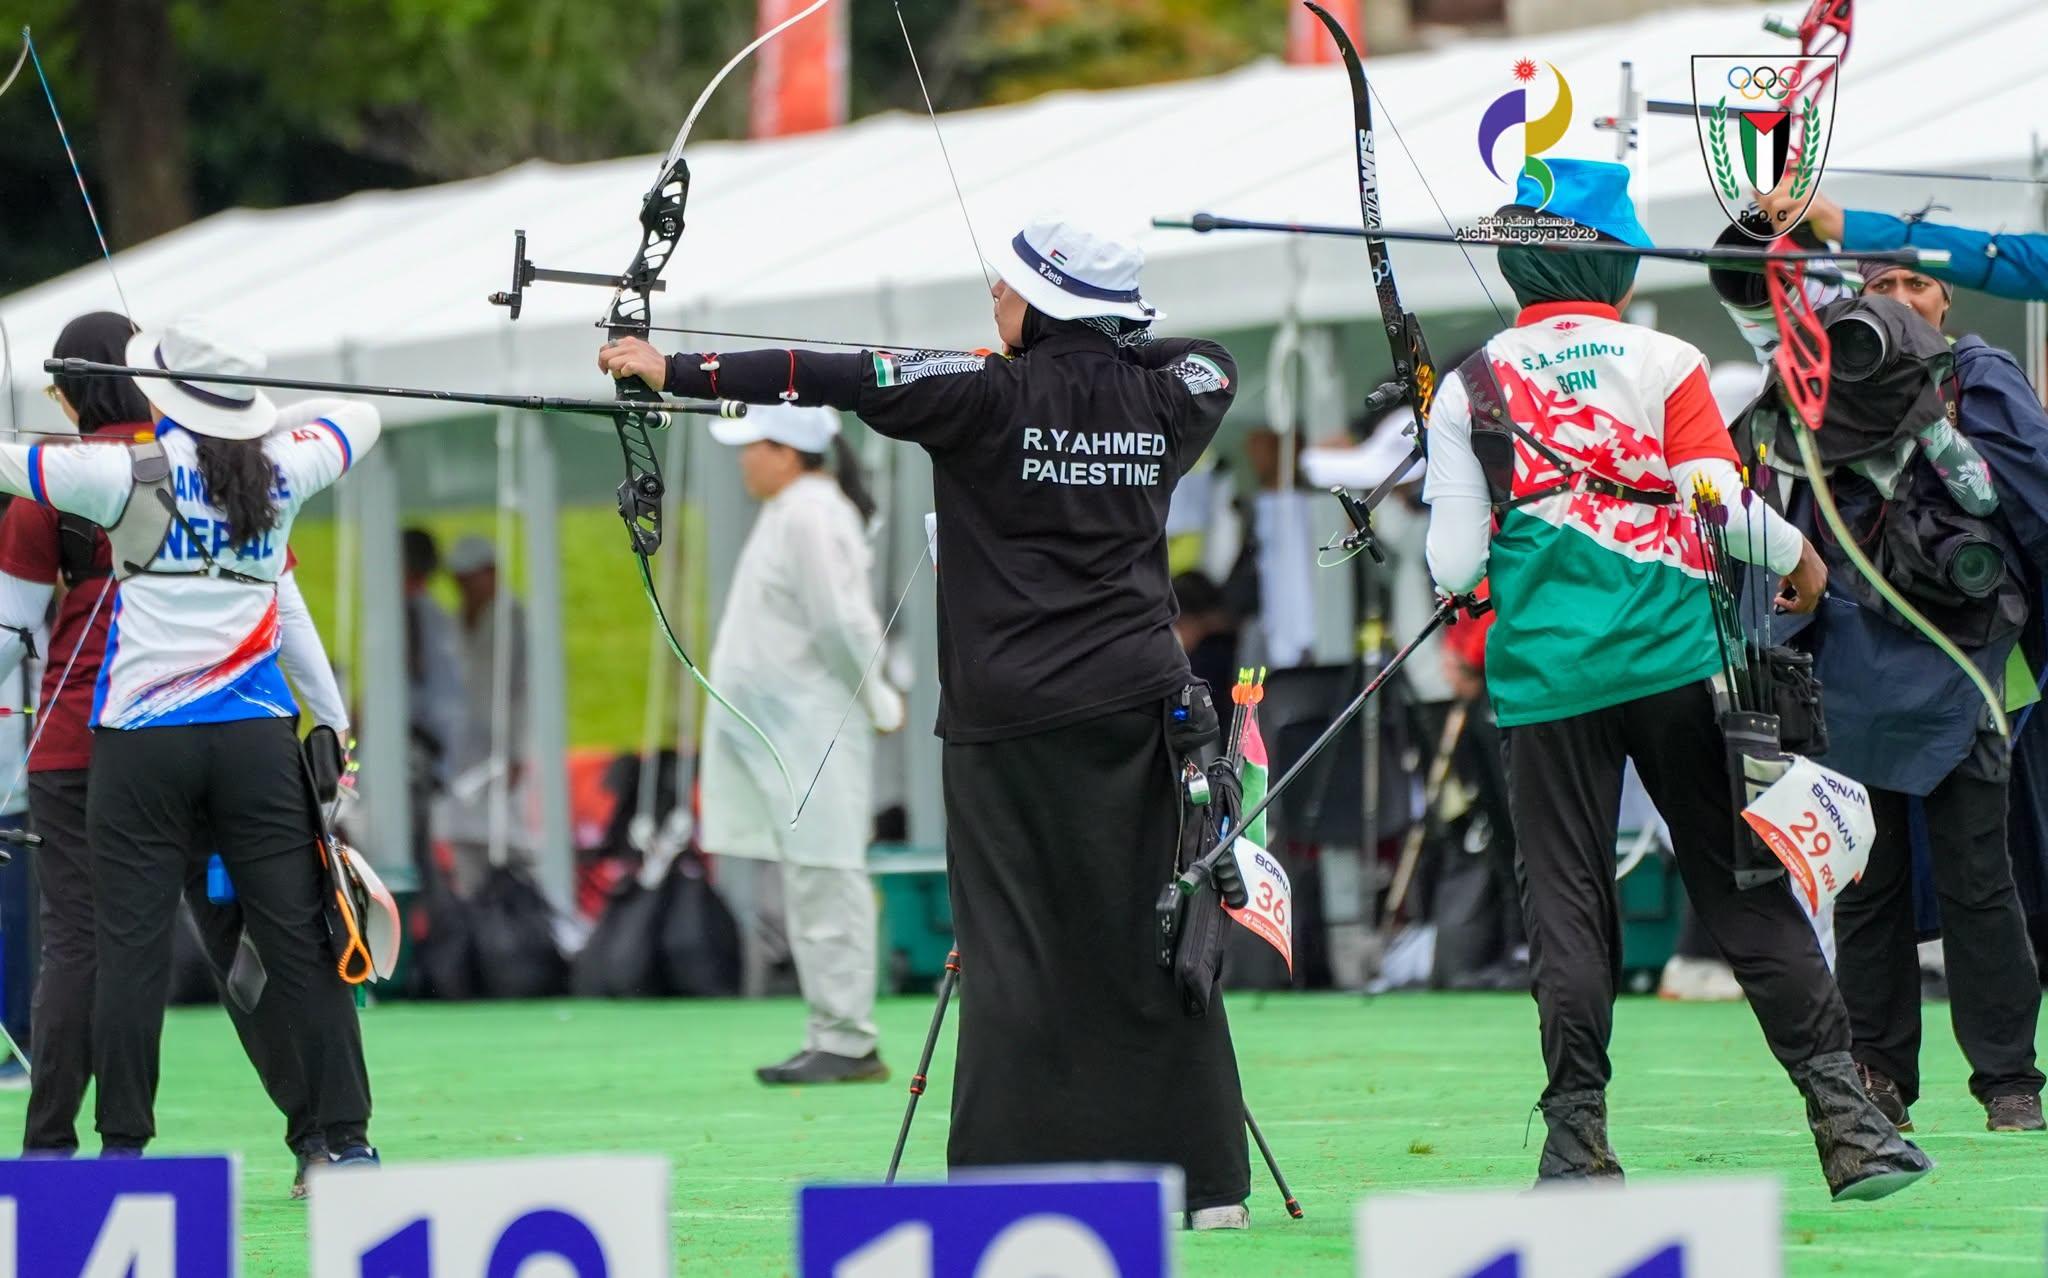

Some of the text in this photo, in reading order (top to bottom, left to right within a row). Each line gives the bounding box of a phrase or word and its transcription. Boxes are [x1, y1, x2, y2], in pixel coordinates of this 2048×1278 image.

[1522, 343, 1624, 370] S.A.SHIMU
[1556, 369, 1597, 395] BAN
[1022, 458, 1161, 486] PALESTINE
[1821, 774, 1866, 806] RNAN
[1811, 782, 1856, 851] BORNAN
[1789, 811, 1832, 858] 29
[1819, 863, 1838, 893] RW
[1255, 853, 1288, 892] BORN
[1256, 881, 1285, 926] 36
